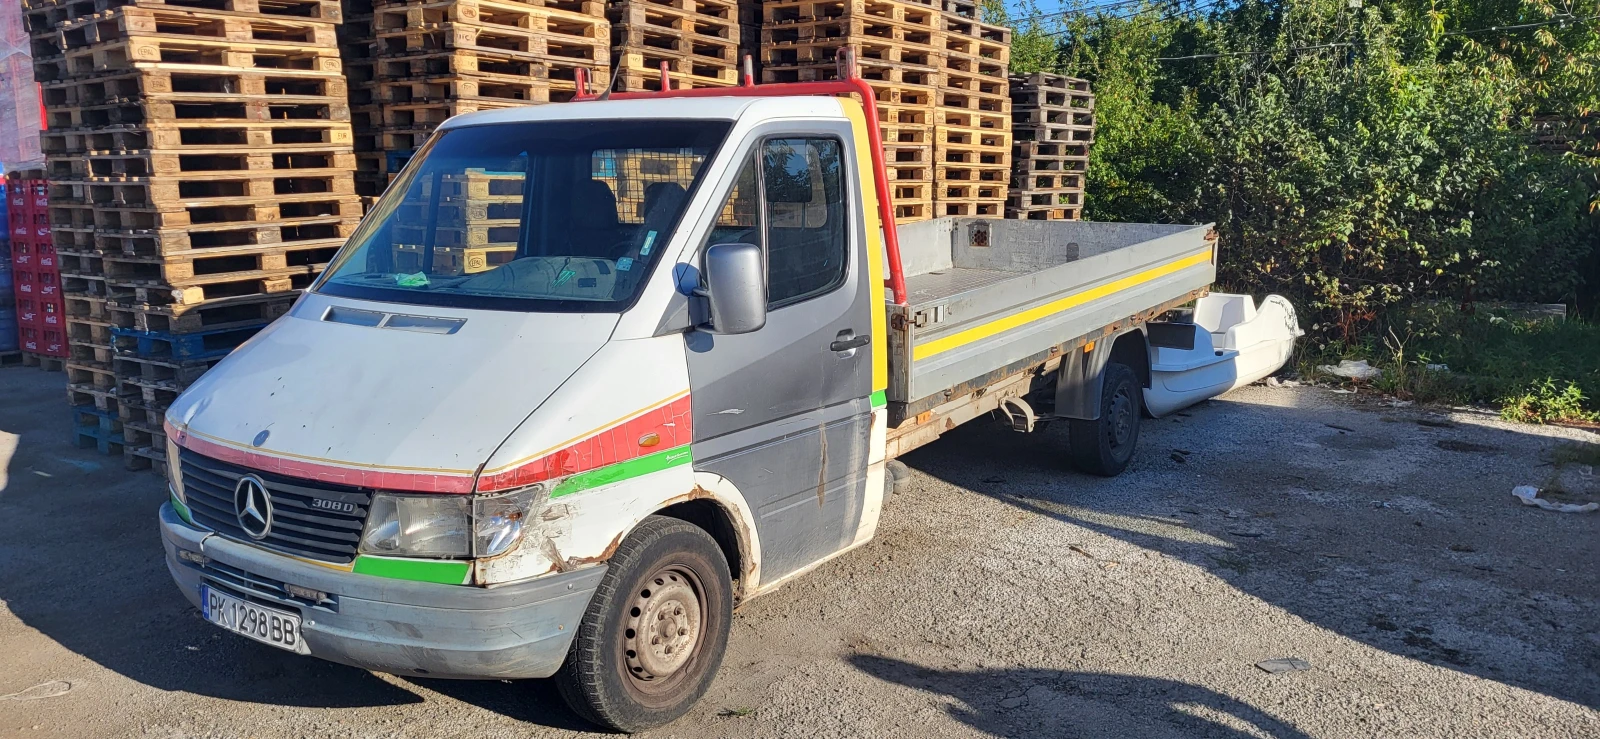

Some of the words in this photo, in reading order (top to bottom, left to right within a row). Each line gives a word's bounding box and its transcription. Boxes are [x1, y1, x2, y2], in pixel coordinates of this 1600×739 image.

[312, 498, 342, 510] 308
[343, 503, 354, 512] D
[209, 592, 229, 624] PK
[231, 602, 268, 638] 1298
[271, 615, 296, 646] BB
